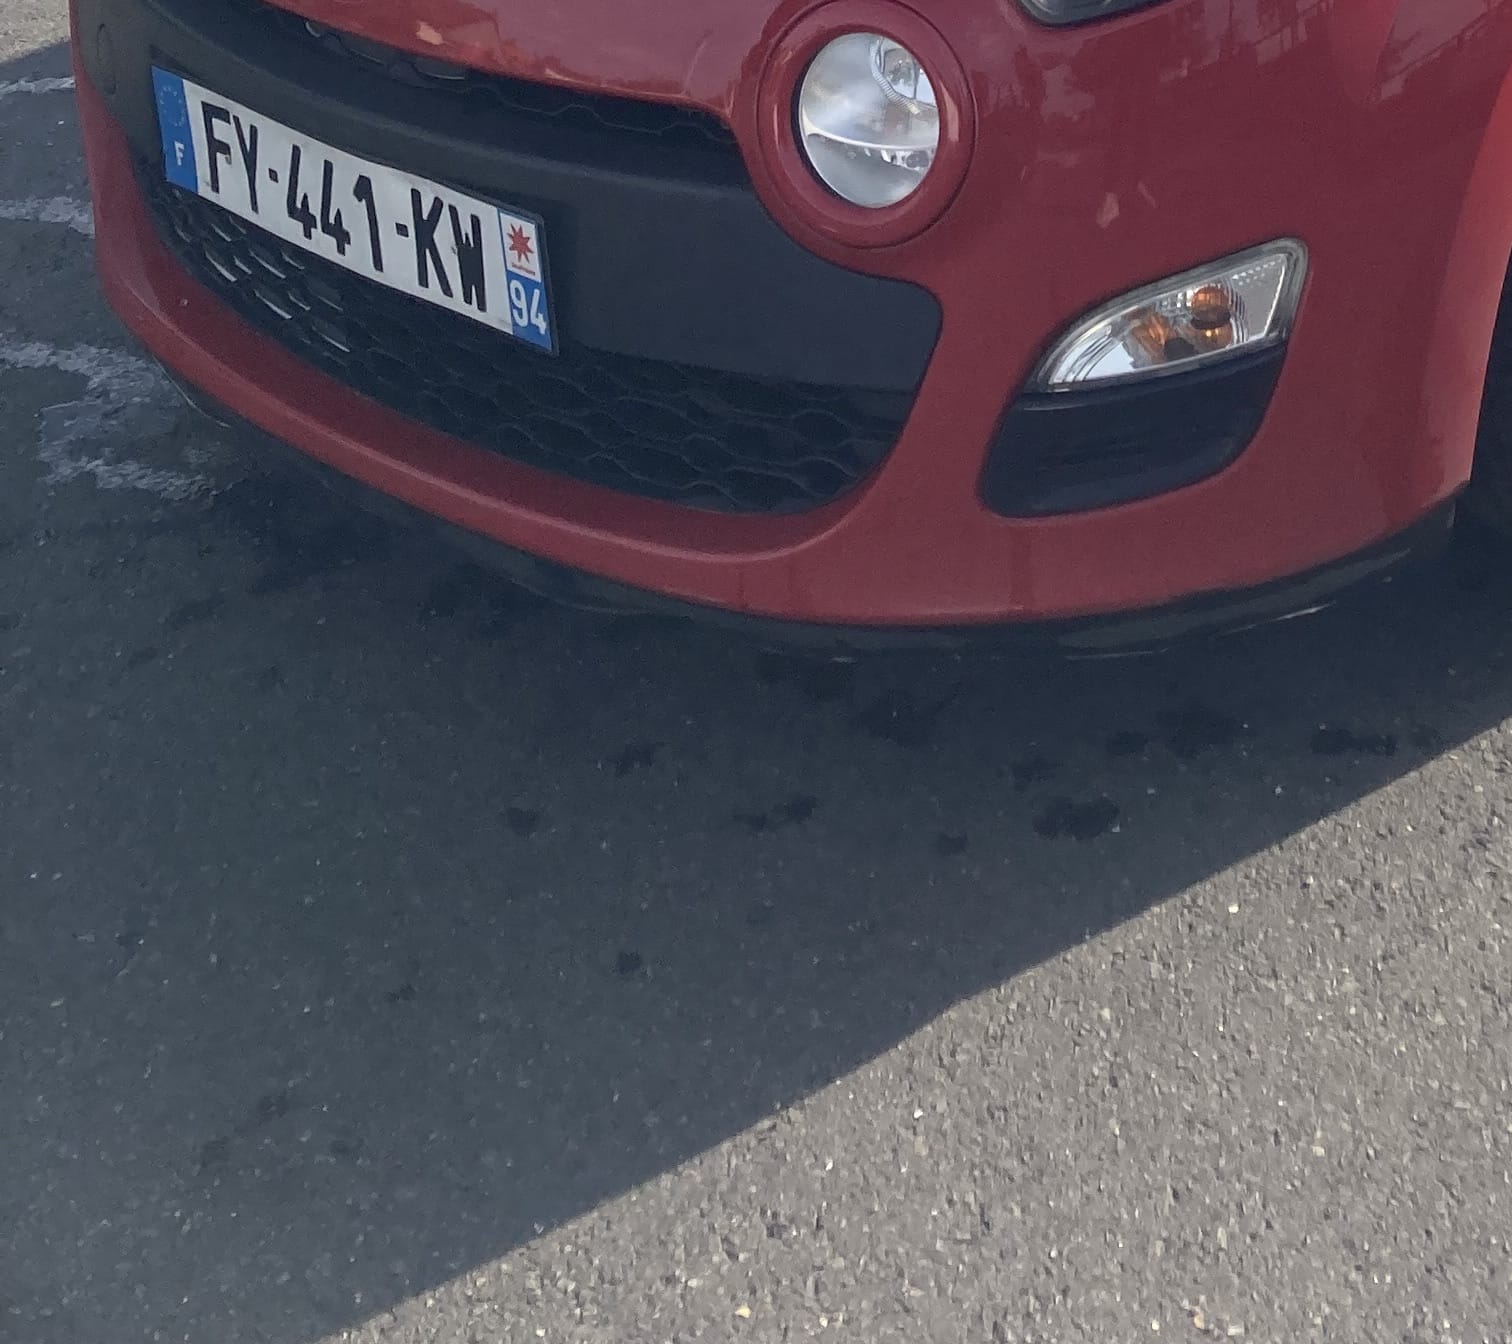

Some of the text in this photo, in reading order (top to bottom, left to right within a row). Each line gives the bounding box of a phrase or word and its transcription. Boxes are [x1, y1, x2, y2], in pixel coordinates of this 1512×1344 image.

[174, 141, 185, 166] F
[201, 101, 487, 313] FY-441-KW
[510, 279, 547, 335] 94
